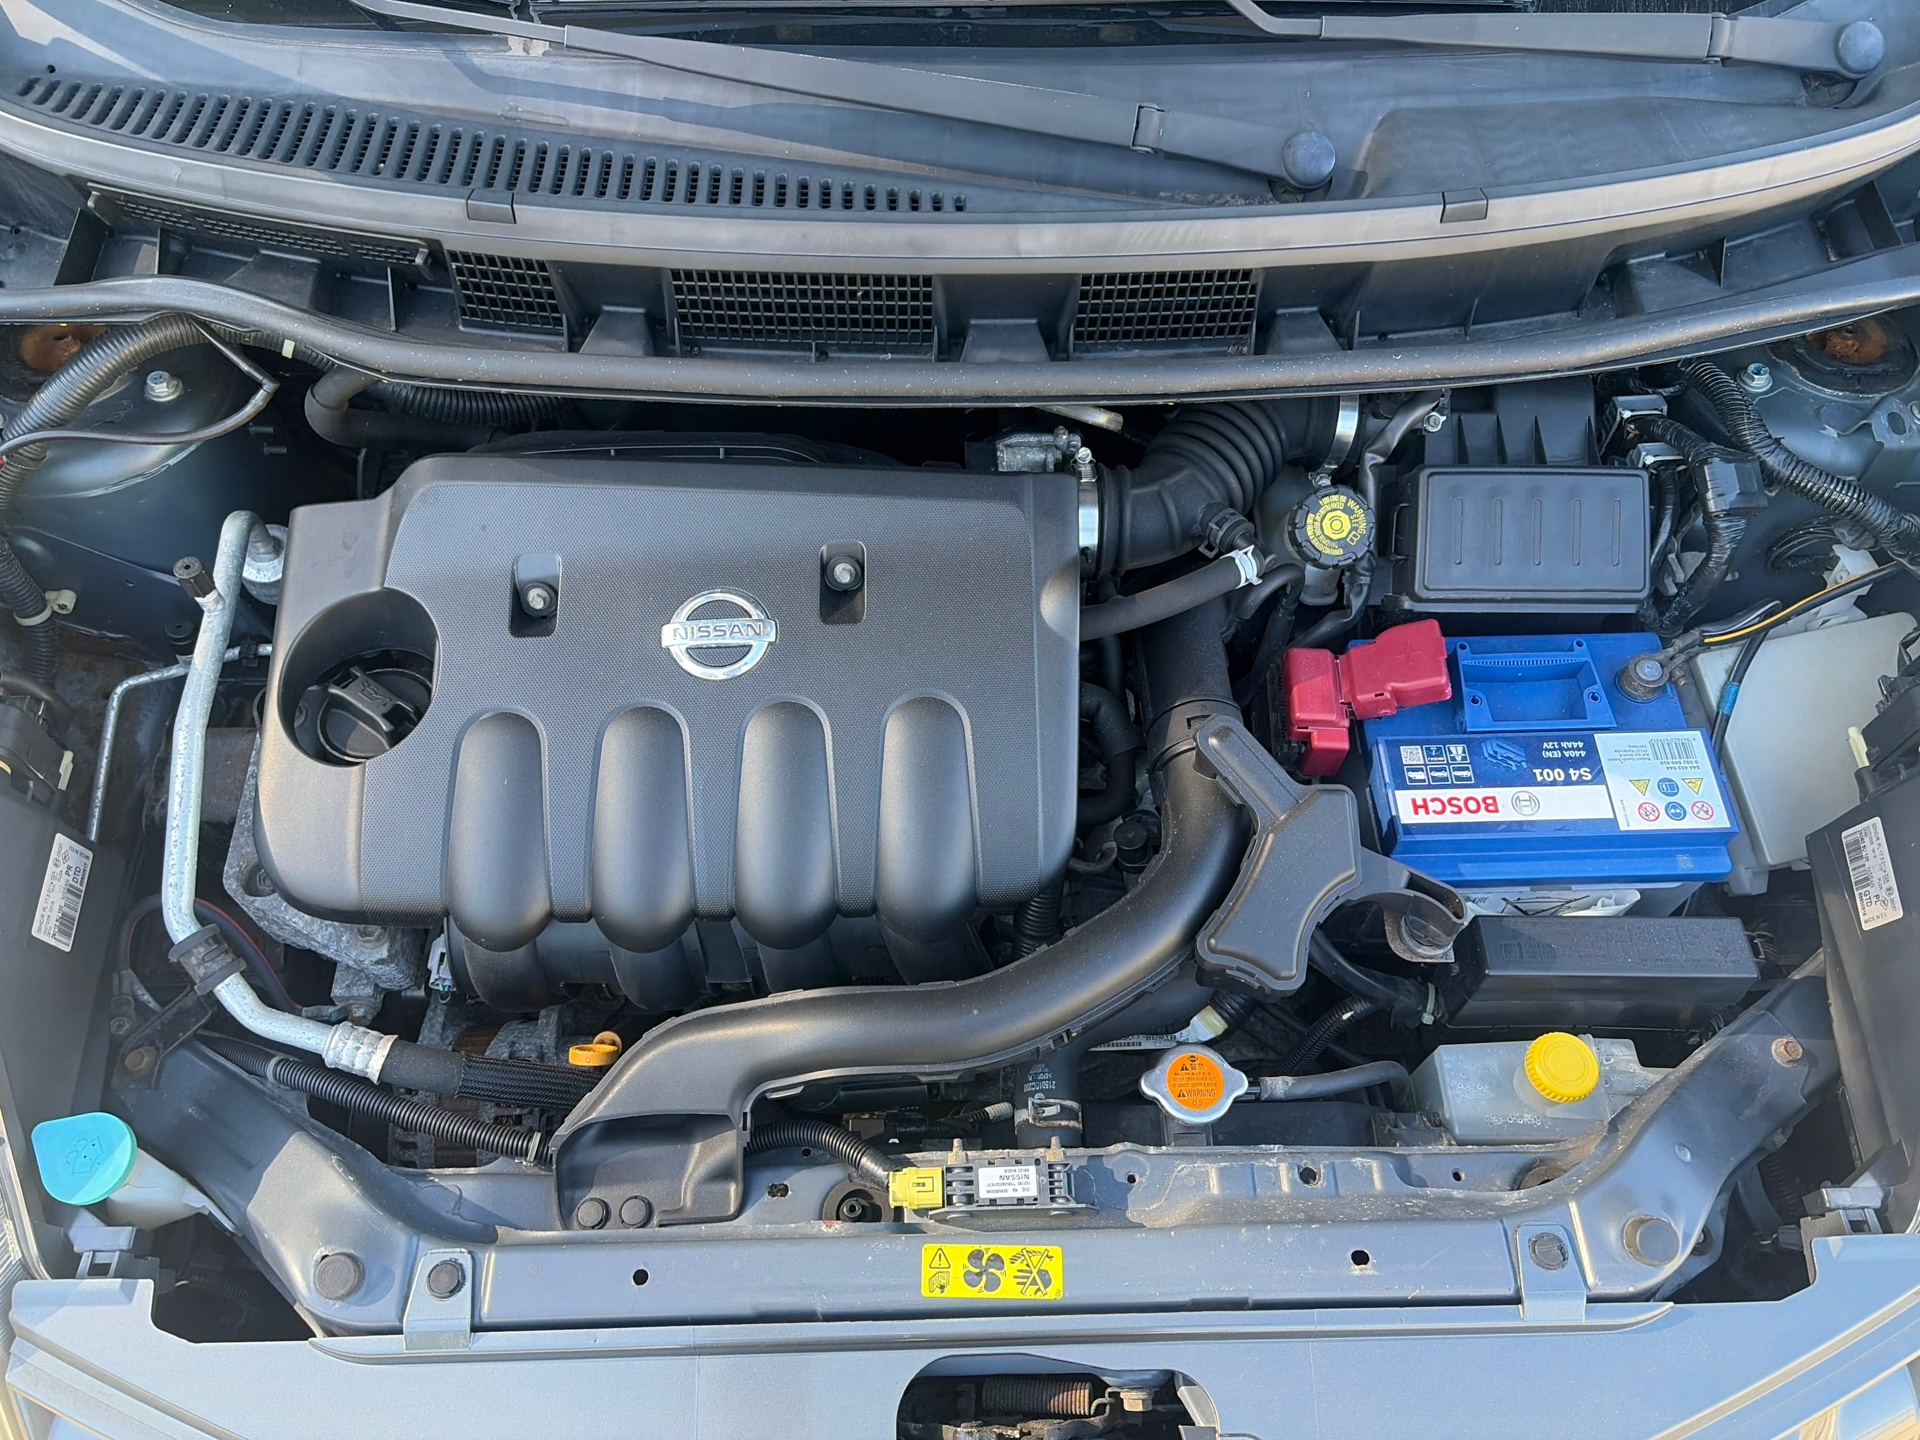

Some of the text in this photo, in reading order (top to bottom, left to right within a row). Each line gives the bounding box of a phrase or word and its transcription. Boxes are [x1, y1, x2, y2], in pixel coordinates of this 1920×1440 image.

[1347, 499, 1366, 534] WARNING
[673, 622, 762, 640] NISSAN
[1542, 750, 1561, 758] (EN)
[1533, 767, 1592, 782] S4 001
[1410, 795, 1499, 815] BOSCH
[65, 865, 73, 877] PR
[72, 866, 82, 883] DTD
[1862, 890, 1873, 908] GTD
[1873, 894, 1881, 905] PL
[1186, 1089, 1216, 1098] WARNING
